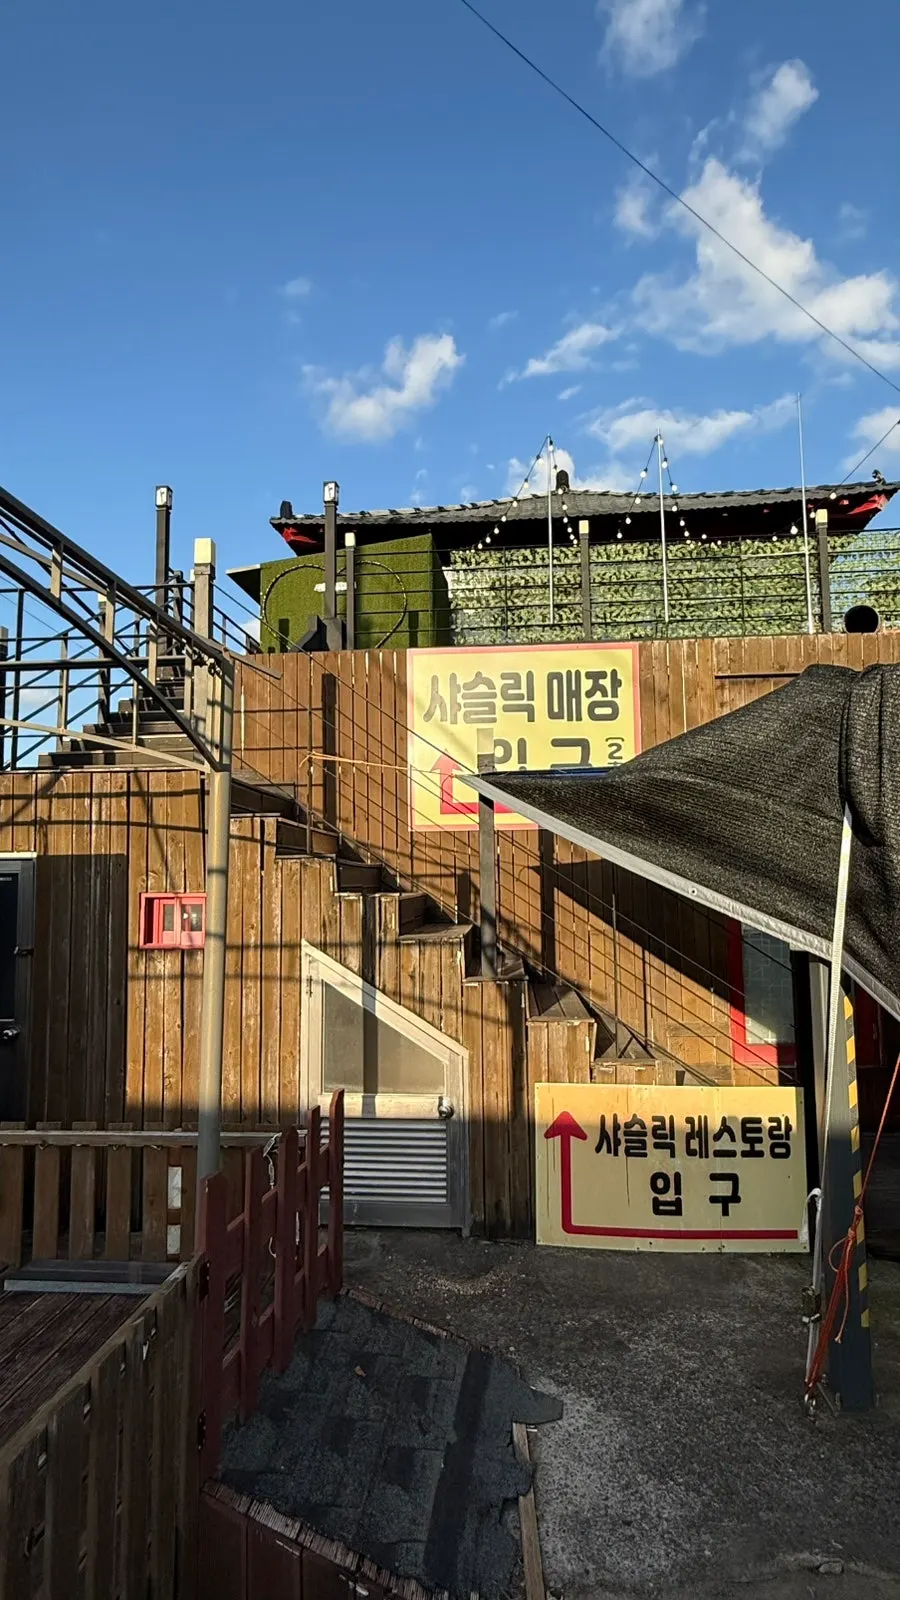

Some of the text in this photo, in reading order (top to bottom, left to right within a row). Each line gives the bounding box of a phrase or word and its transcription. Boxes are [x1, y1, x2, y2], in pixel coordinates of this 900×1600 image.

[423, 669, 623, 725] 샤슬릭 매장
[595, 1113, 793, 1159] 샤슬릭 레스토랑
